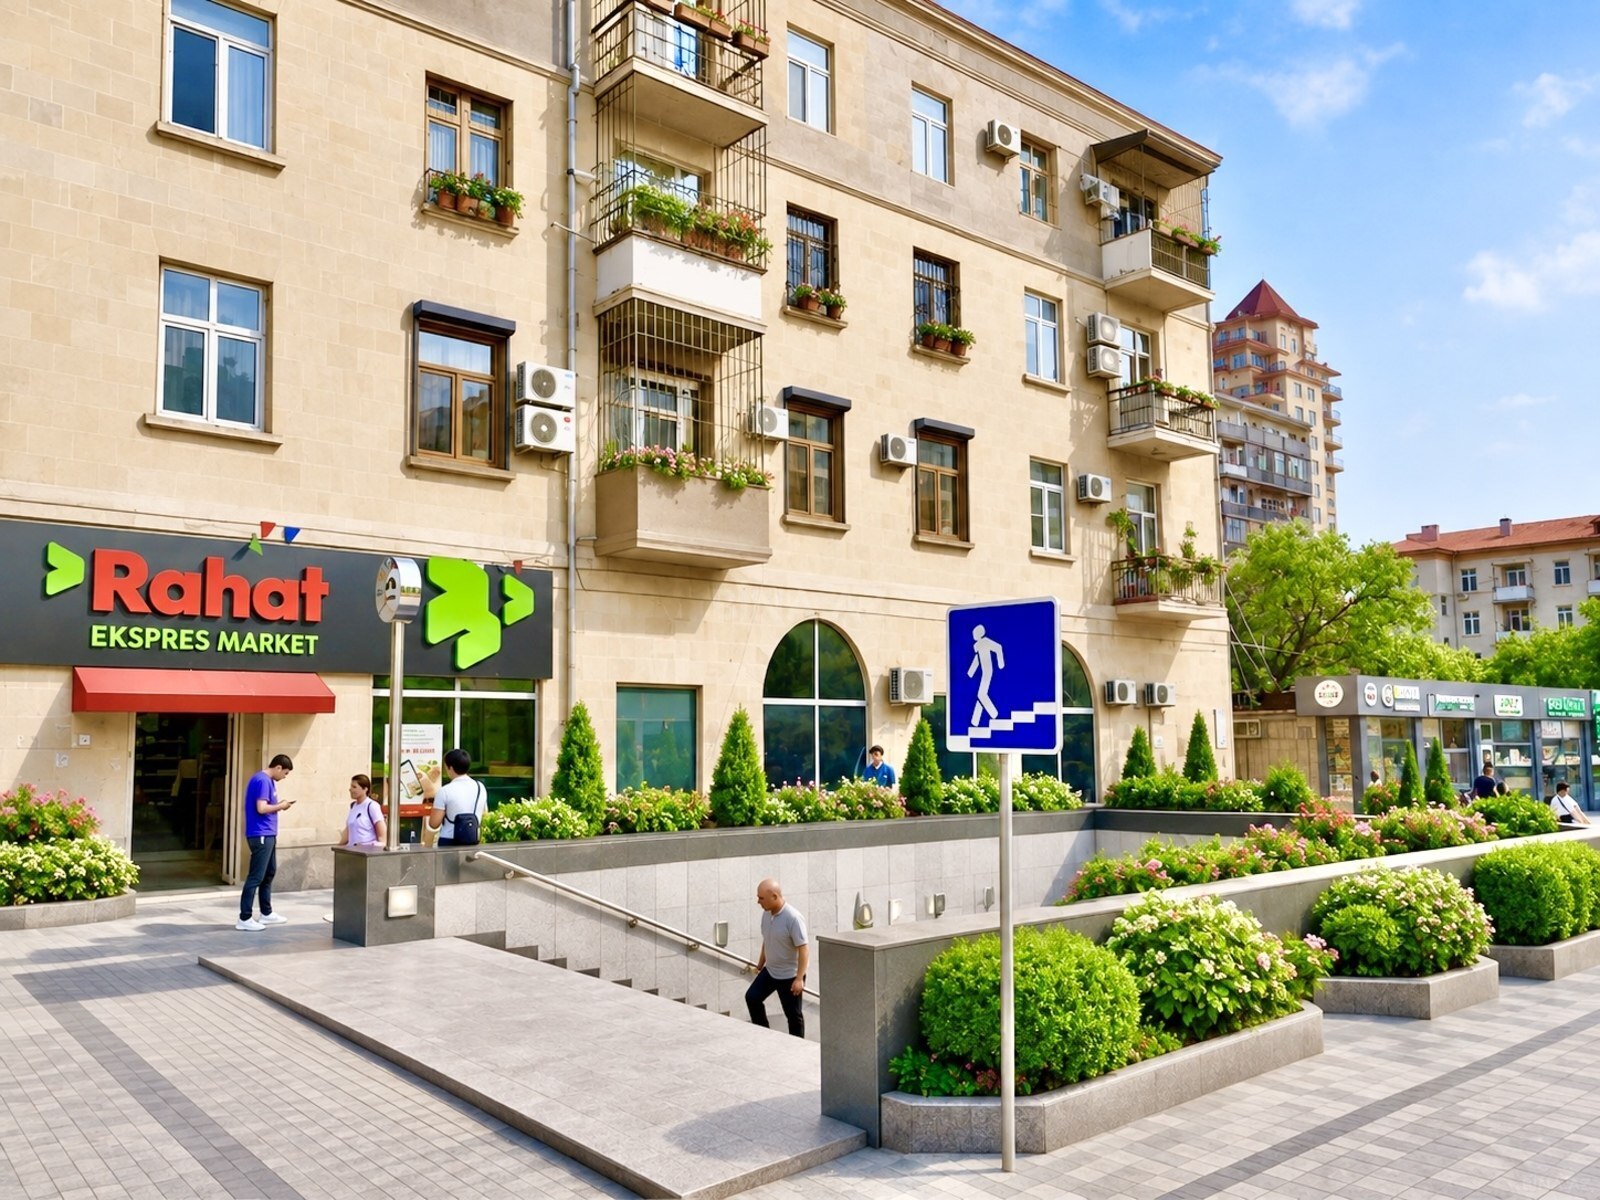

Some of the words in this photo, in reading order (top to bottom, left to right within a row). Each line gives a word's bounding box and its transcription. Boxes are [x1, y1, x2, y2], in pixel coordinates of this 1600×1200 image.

[92, 549, 329, 622] Rahat
[91, 624, 211, 652] EKSPRES
[216, 630, 319, 656] MARKET
